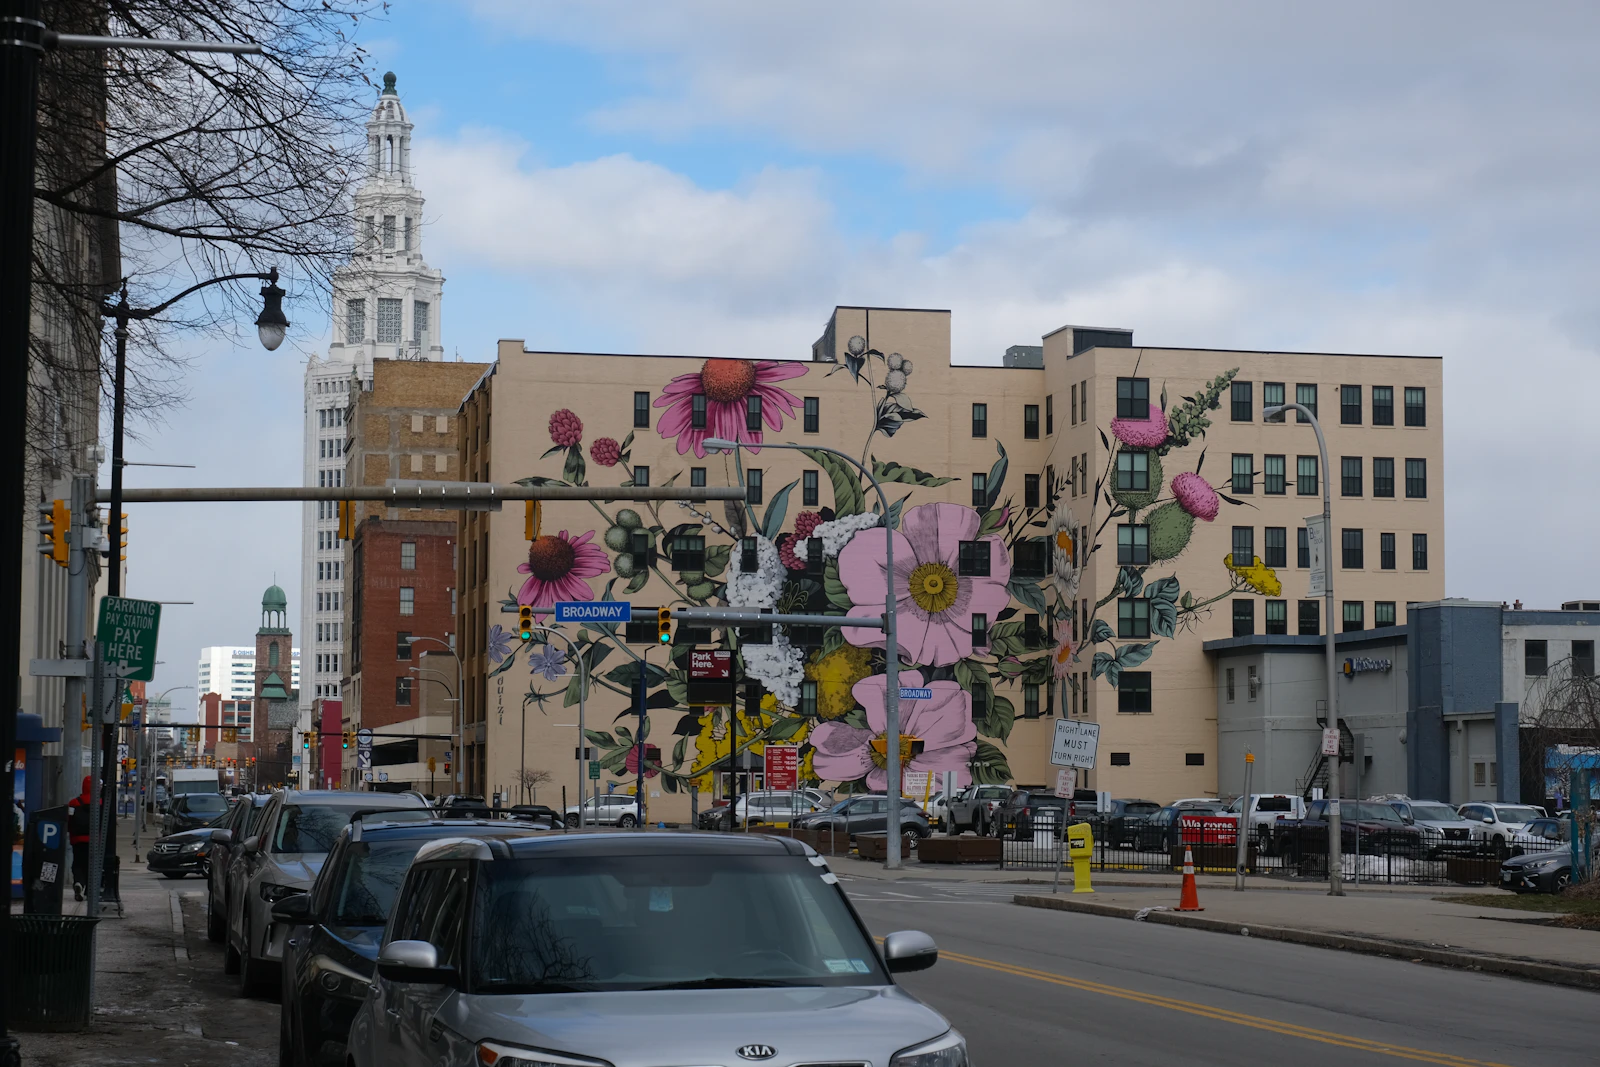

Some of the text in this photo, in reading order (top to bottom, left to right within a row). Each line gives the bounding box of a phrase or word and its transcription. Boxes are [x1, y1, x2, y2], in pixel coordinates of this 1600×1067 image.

[106, 597, 156, 616] PARKING
[562, 606, 623, 618] BROADWAY
[105, 612, 154, 630] PAY STATION
[114, 627, 141, 644] PAY
[107, 642, 143, 661] HERE
[692, 652, 711, 661] Park
[692, 660, 714, 668] Here.
[901, 689, 932, 698] BROADWAY
[1057, 724, 1097, 738] RIGHT LANE
[1063, 738, 1088, 750] MUST
[1054, 751, 1094, 764] TURN RIGHT
[743, 1045, 773, 1057] KIA
